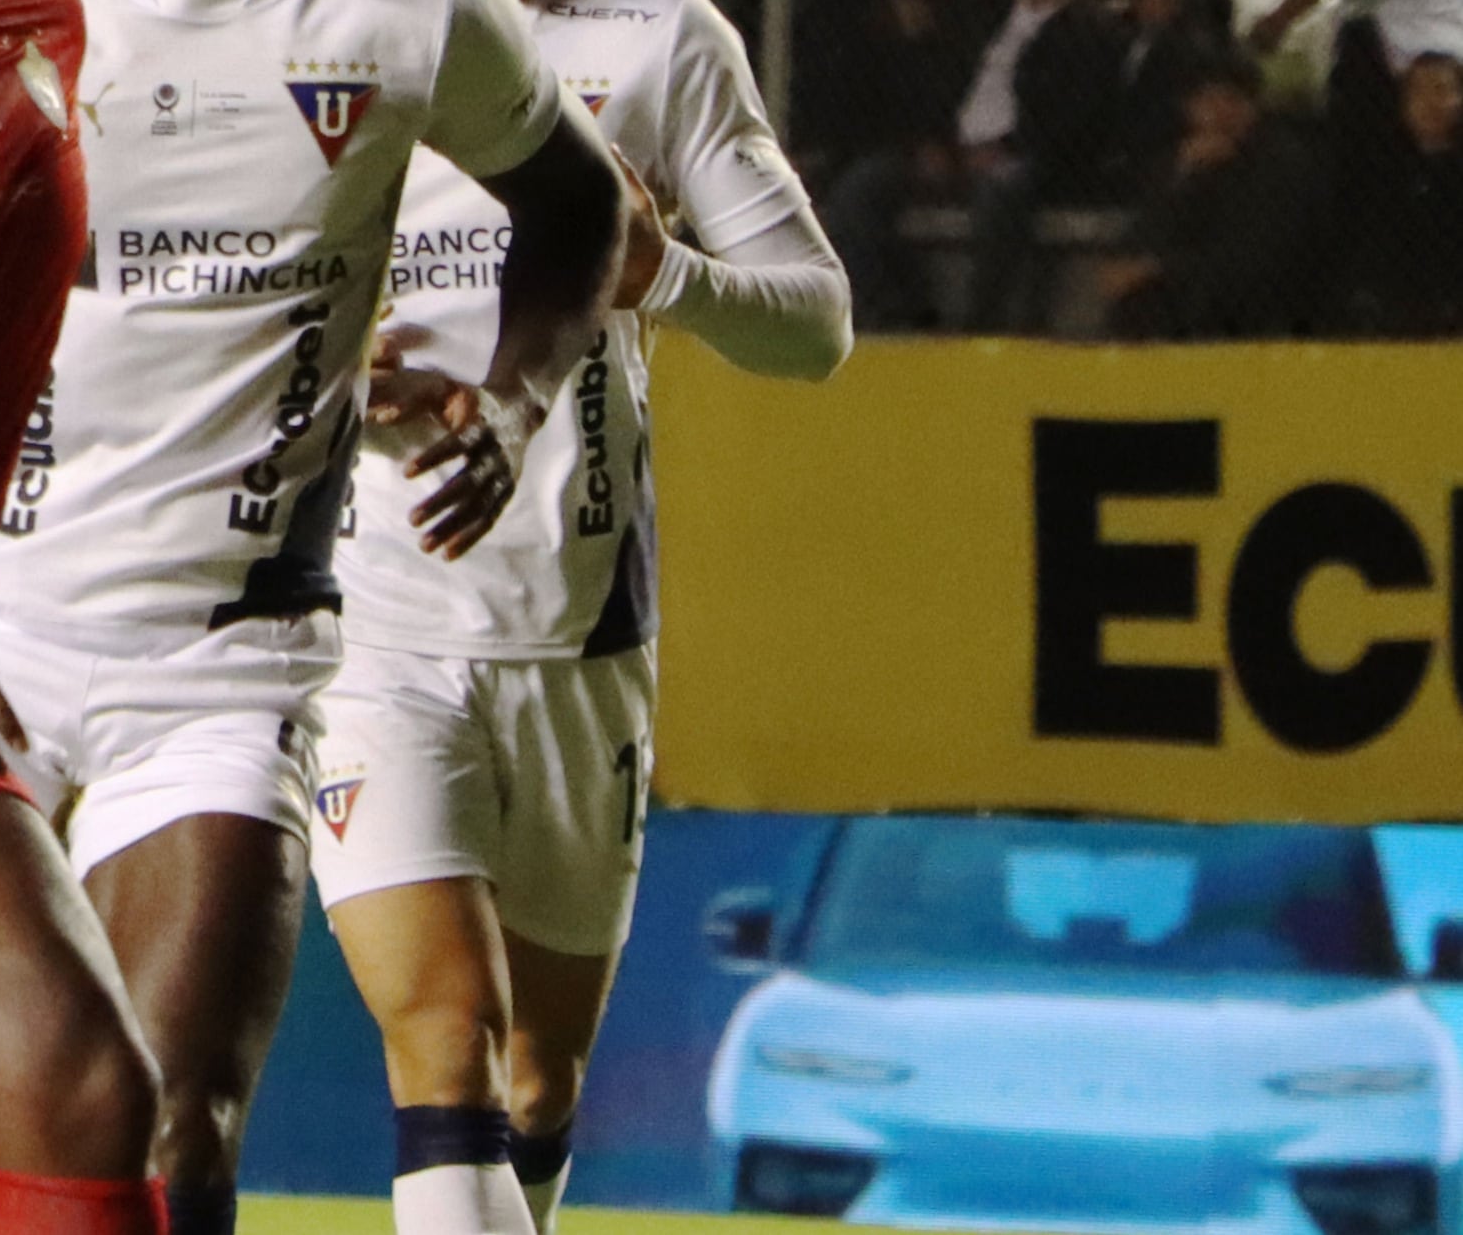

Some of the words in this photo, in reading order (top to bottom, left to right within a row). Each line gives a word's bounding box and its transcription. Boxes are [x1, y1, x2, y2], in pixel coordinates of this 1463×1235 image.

[548, 5, 660, 24] CHERY
[119, 229, 276, 259] BANCO
[119, 255, 348, 297] PICHINCHA
